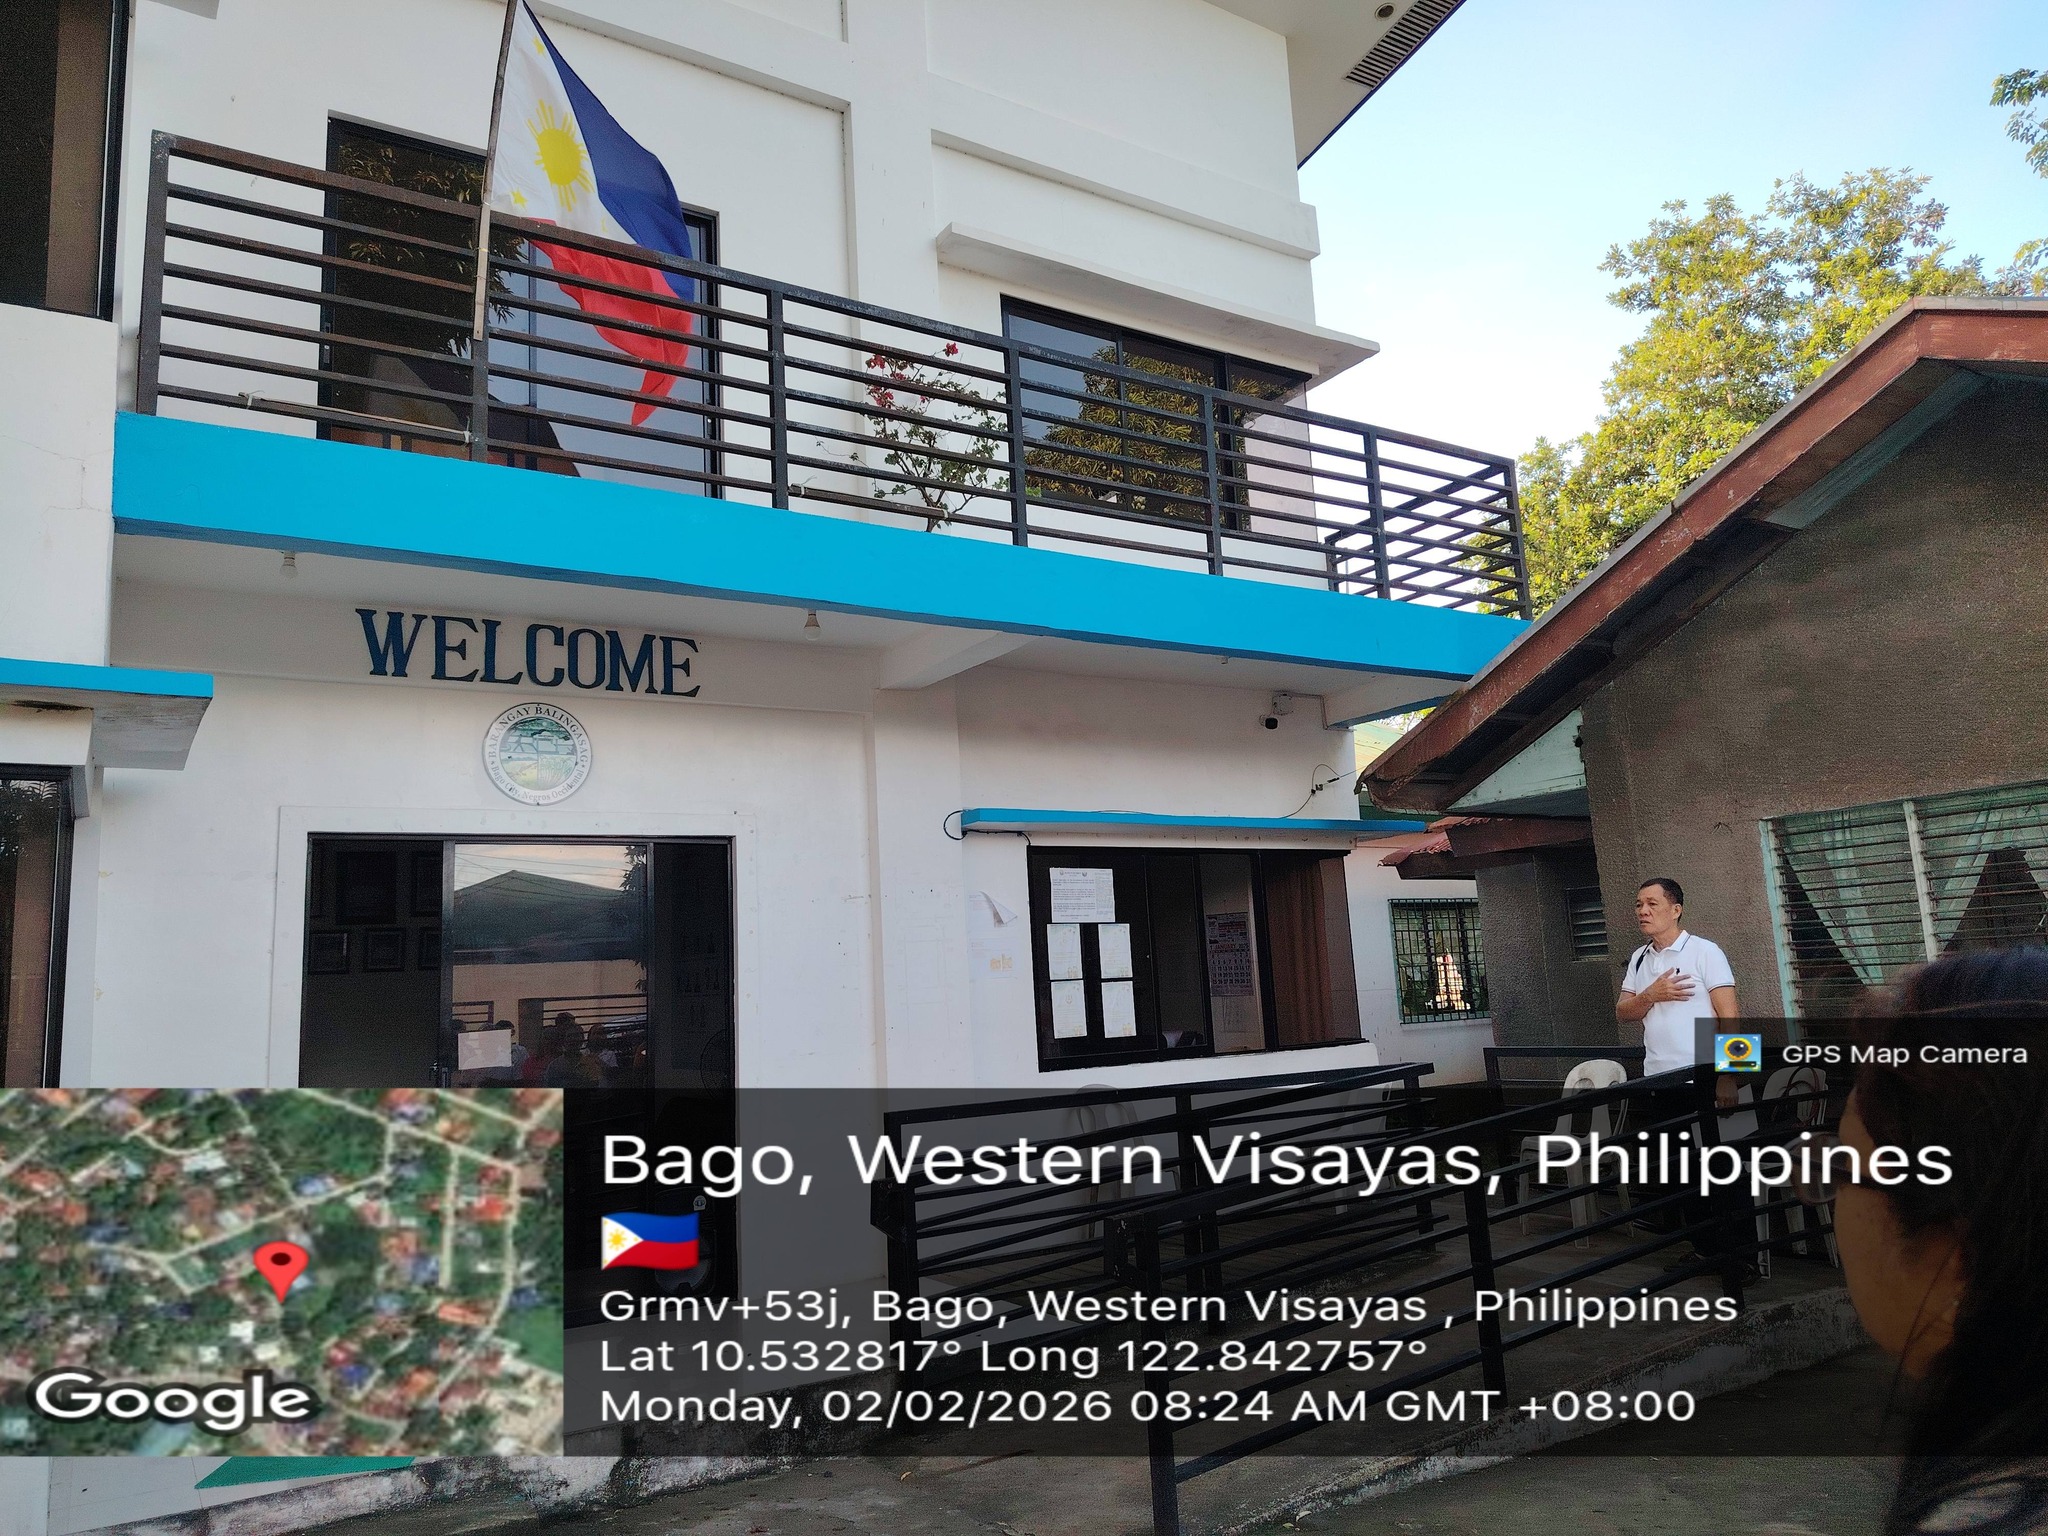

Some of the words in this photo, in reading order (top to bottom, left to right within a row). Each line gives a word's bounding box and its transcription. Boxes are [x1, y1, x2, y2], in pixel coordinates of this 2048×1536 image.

[355, 608, 701, 697] WELCOME
[488, 706, 531, 759] BARANGAY
[534, 706, 589, 764] BALINGASAG
[490, 765, 506, 785] Bago
[521, 791, 551, 803] Negros
